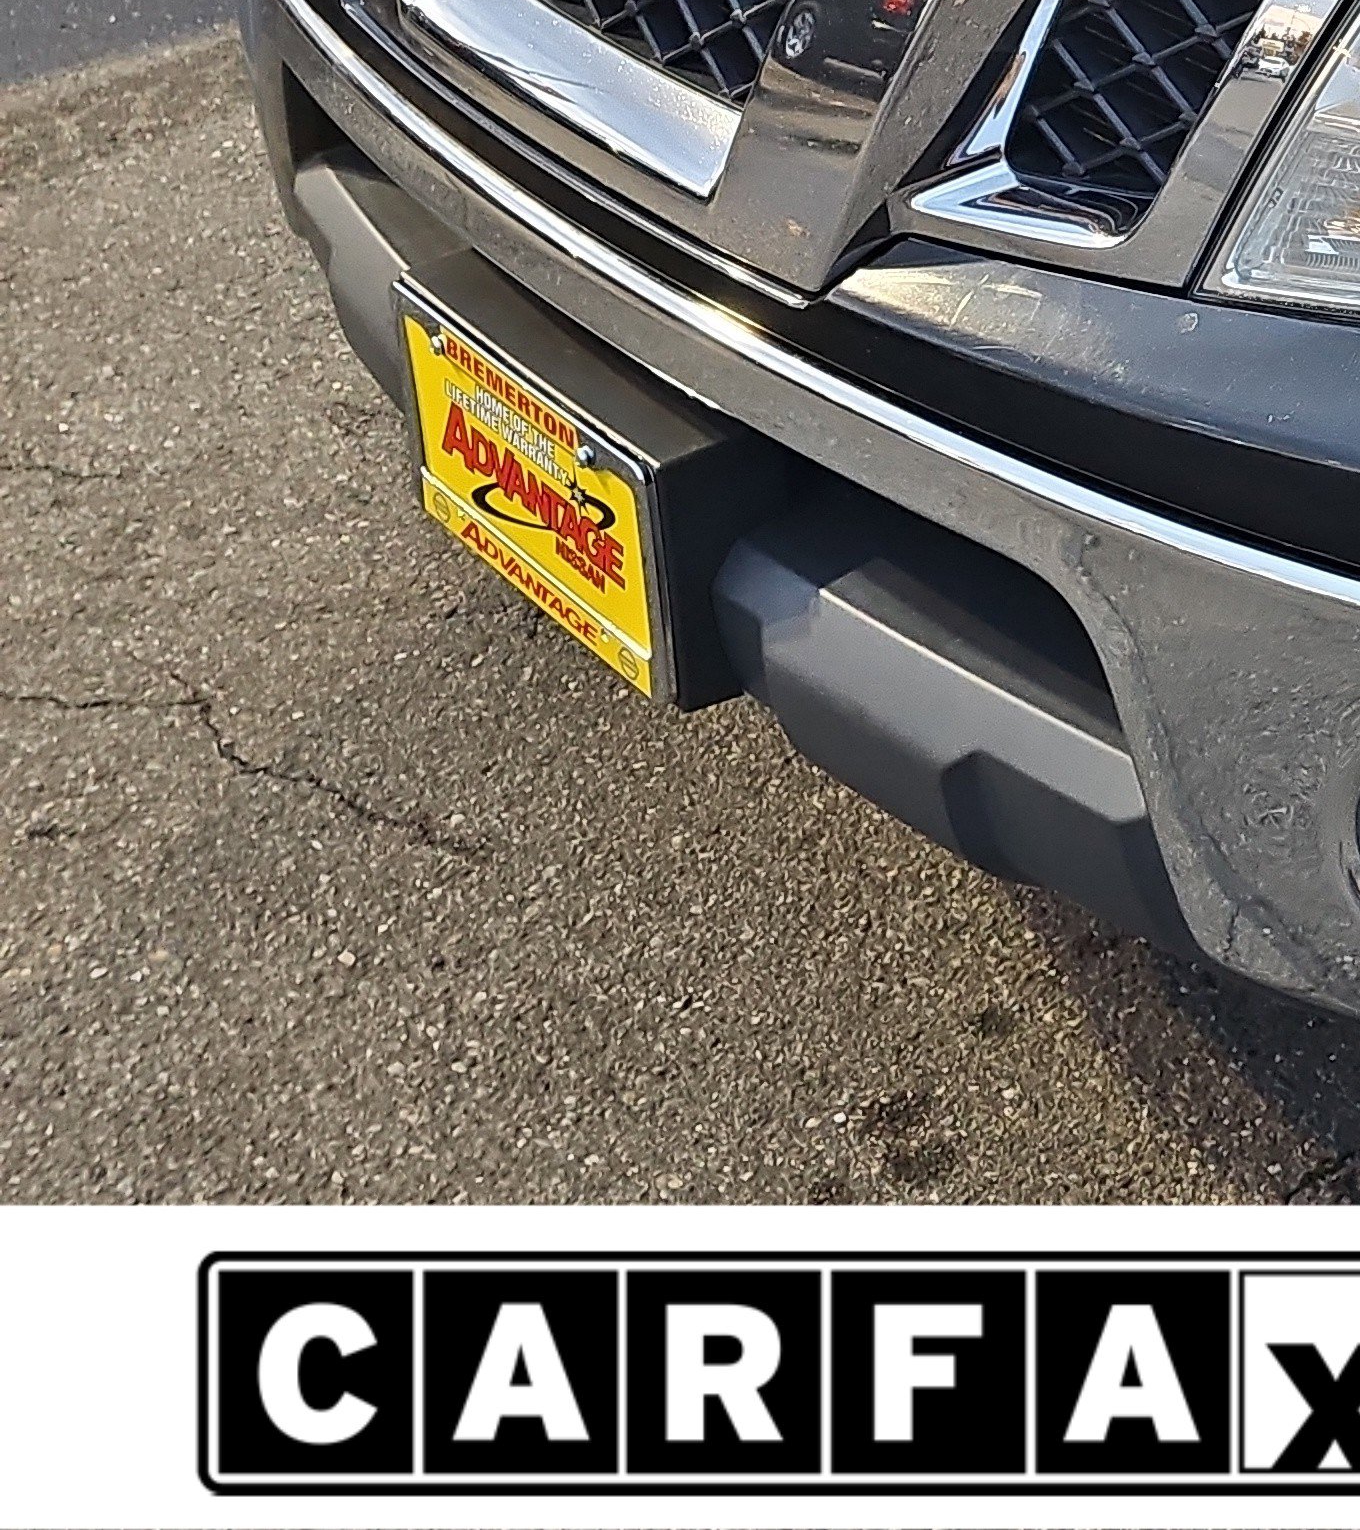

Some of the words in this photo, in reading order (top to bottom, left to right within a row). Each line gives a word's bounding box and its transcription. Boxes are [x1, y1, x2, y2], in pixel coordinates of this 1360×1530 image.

[445, 379, 500, 435] LIFETIME
[501, 425, 570, 486] WARRANTY
[446, 336, 575, 450] BREMERTON
[475, 384, 511, 424] HOME
[513, 412, 531, 435] OF
[532, 427, 555, 459] THE
[441, 404, 627, 591] ADVANTAGE
[461, 521, 600, 647] ADVANTAGE
[555, 538, 607, 594] NISSAN
